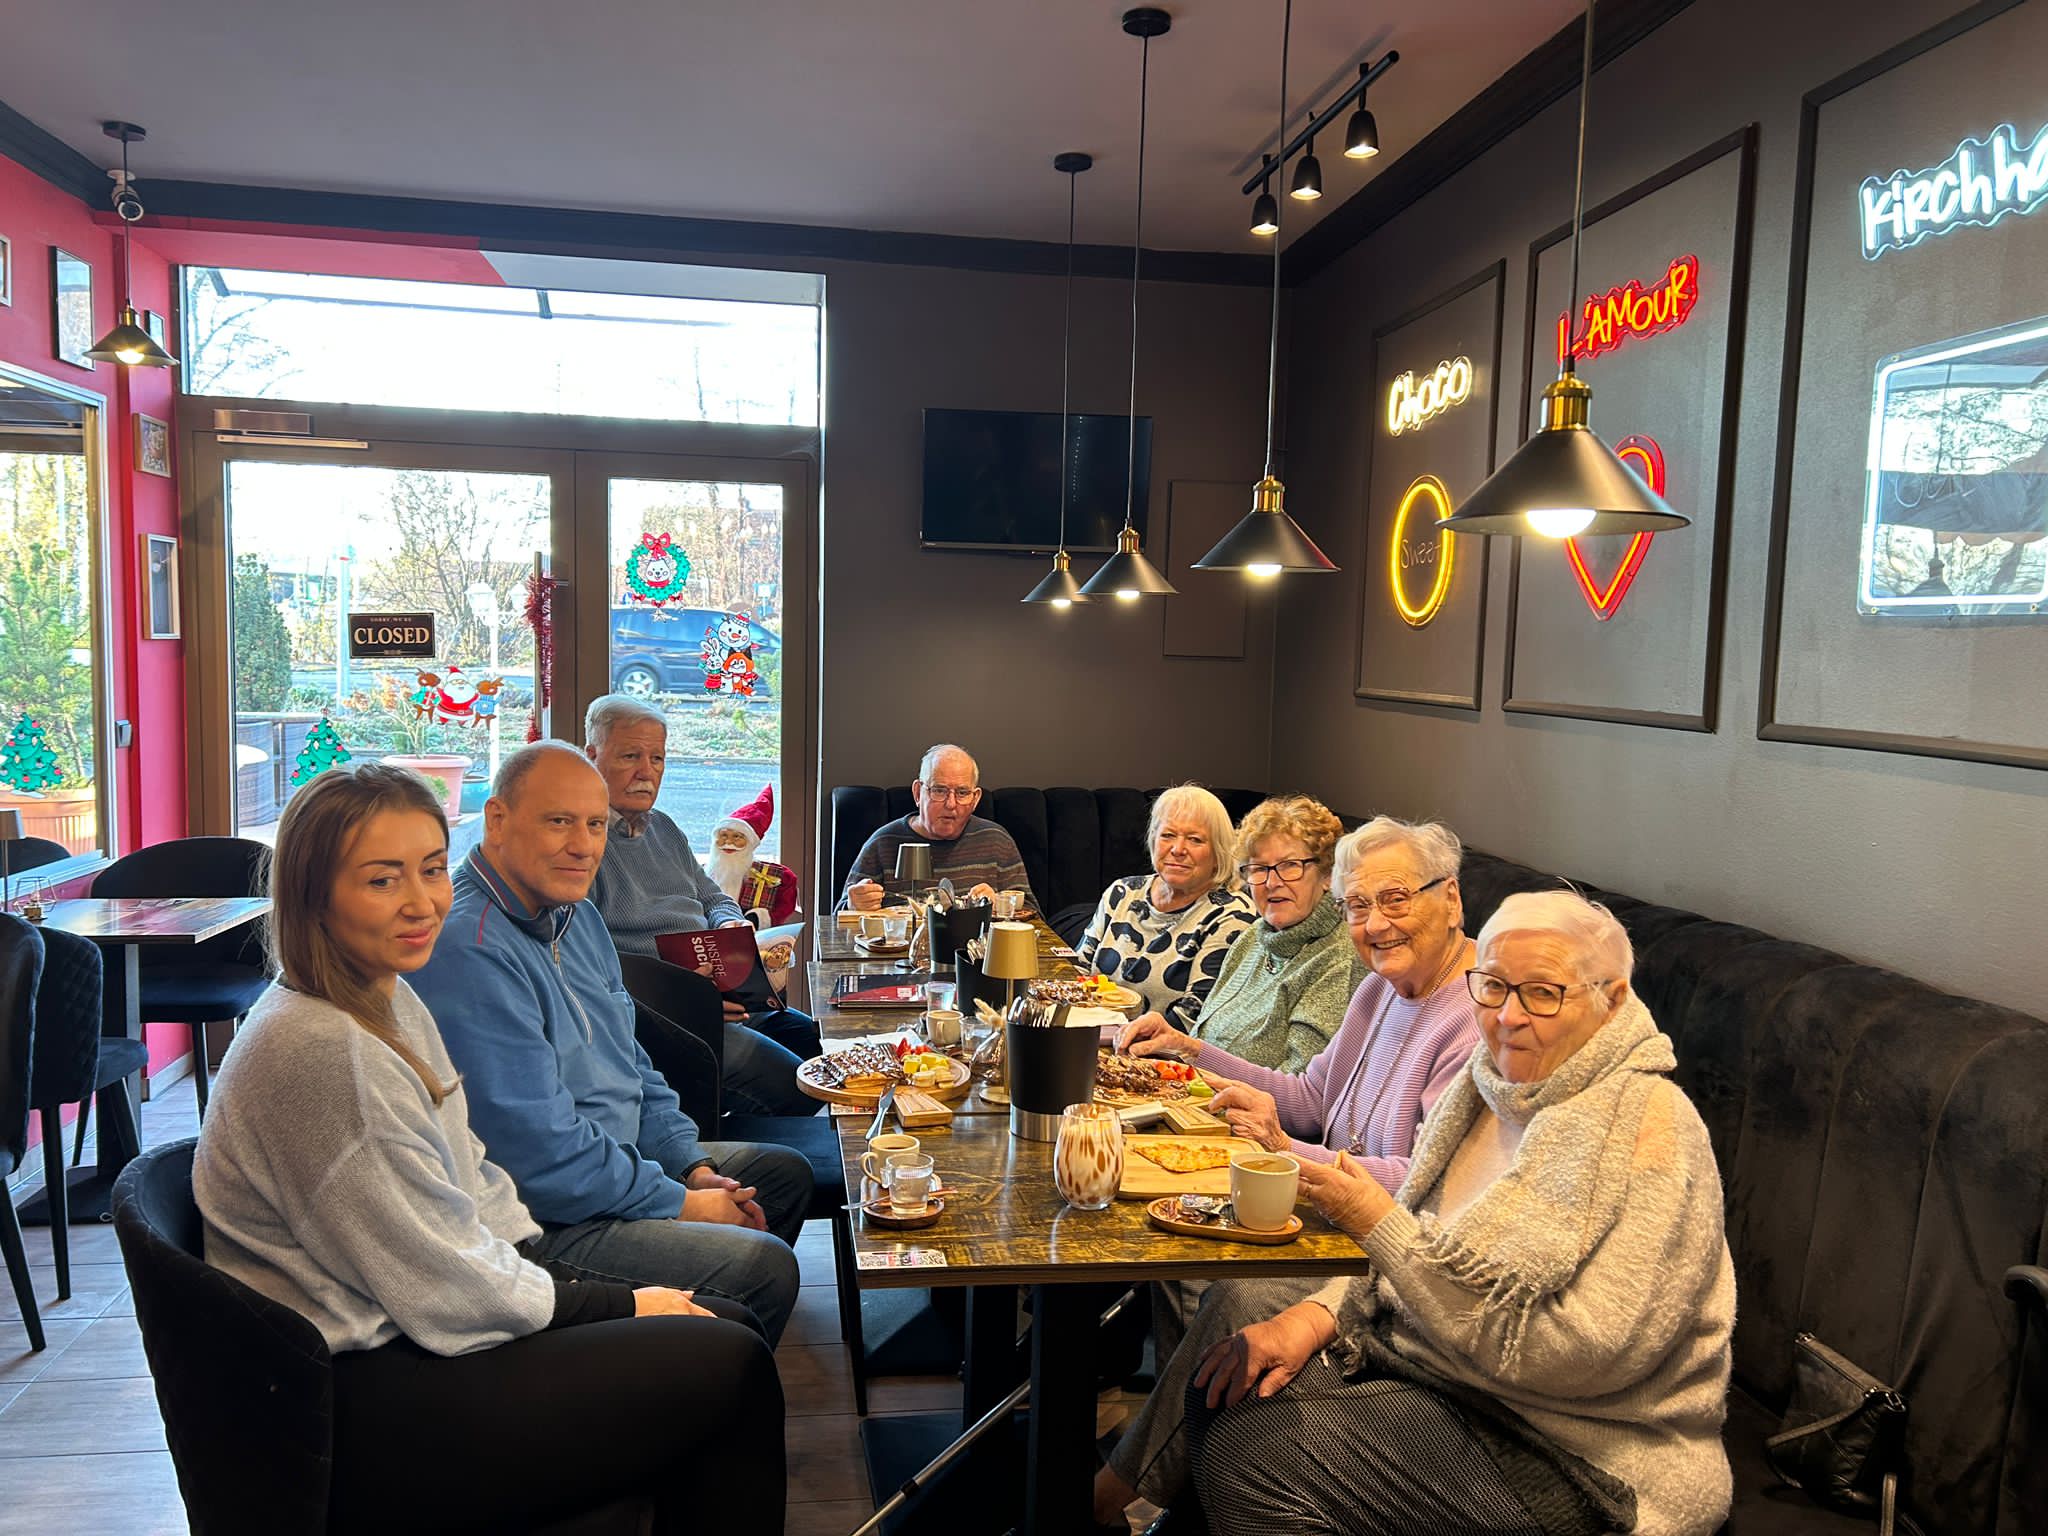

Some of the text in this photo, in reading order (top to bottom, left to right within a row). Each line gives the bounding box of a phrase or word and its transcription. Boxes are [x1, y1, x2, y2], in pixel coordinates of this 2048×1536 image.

[1558, 263, 1690, 364] L'AMOUR
[354, 627, 430, 645] CLOSED
[691, 936, 709, 967] SOCI
[703, 935, 728, 977] UNSERE
